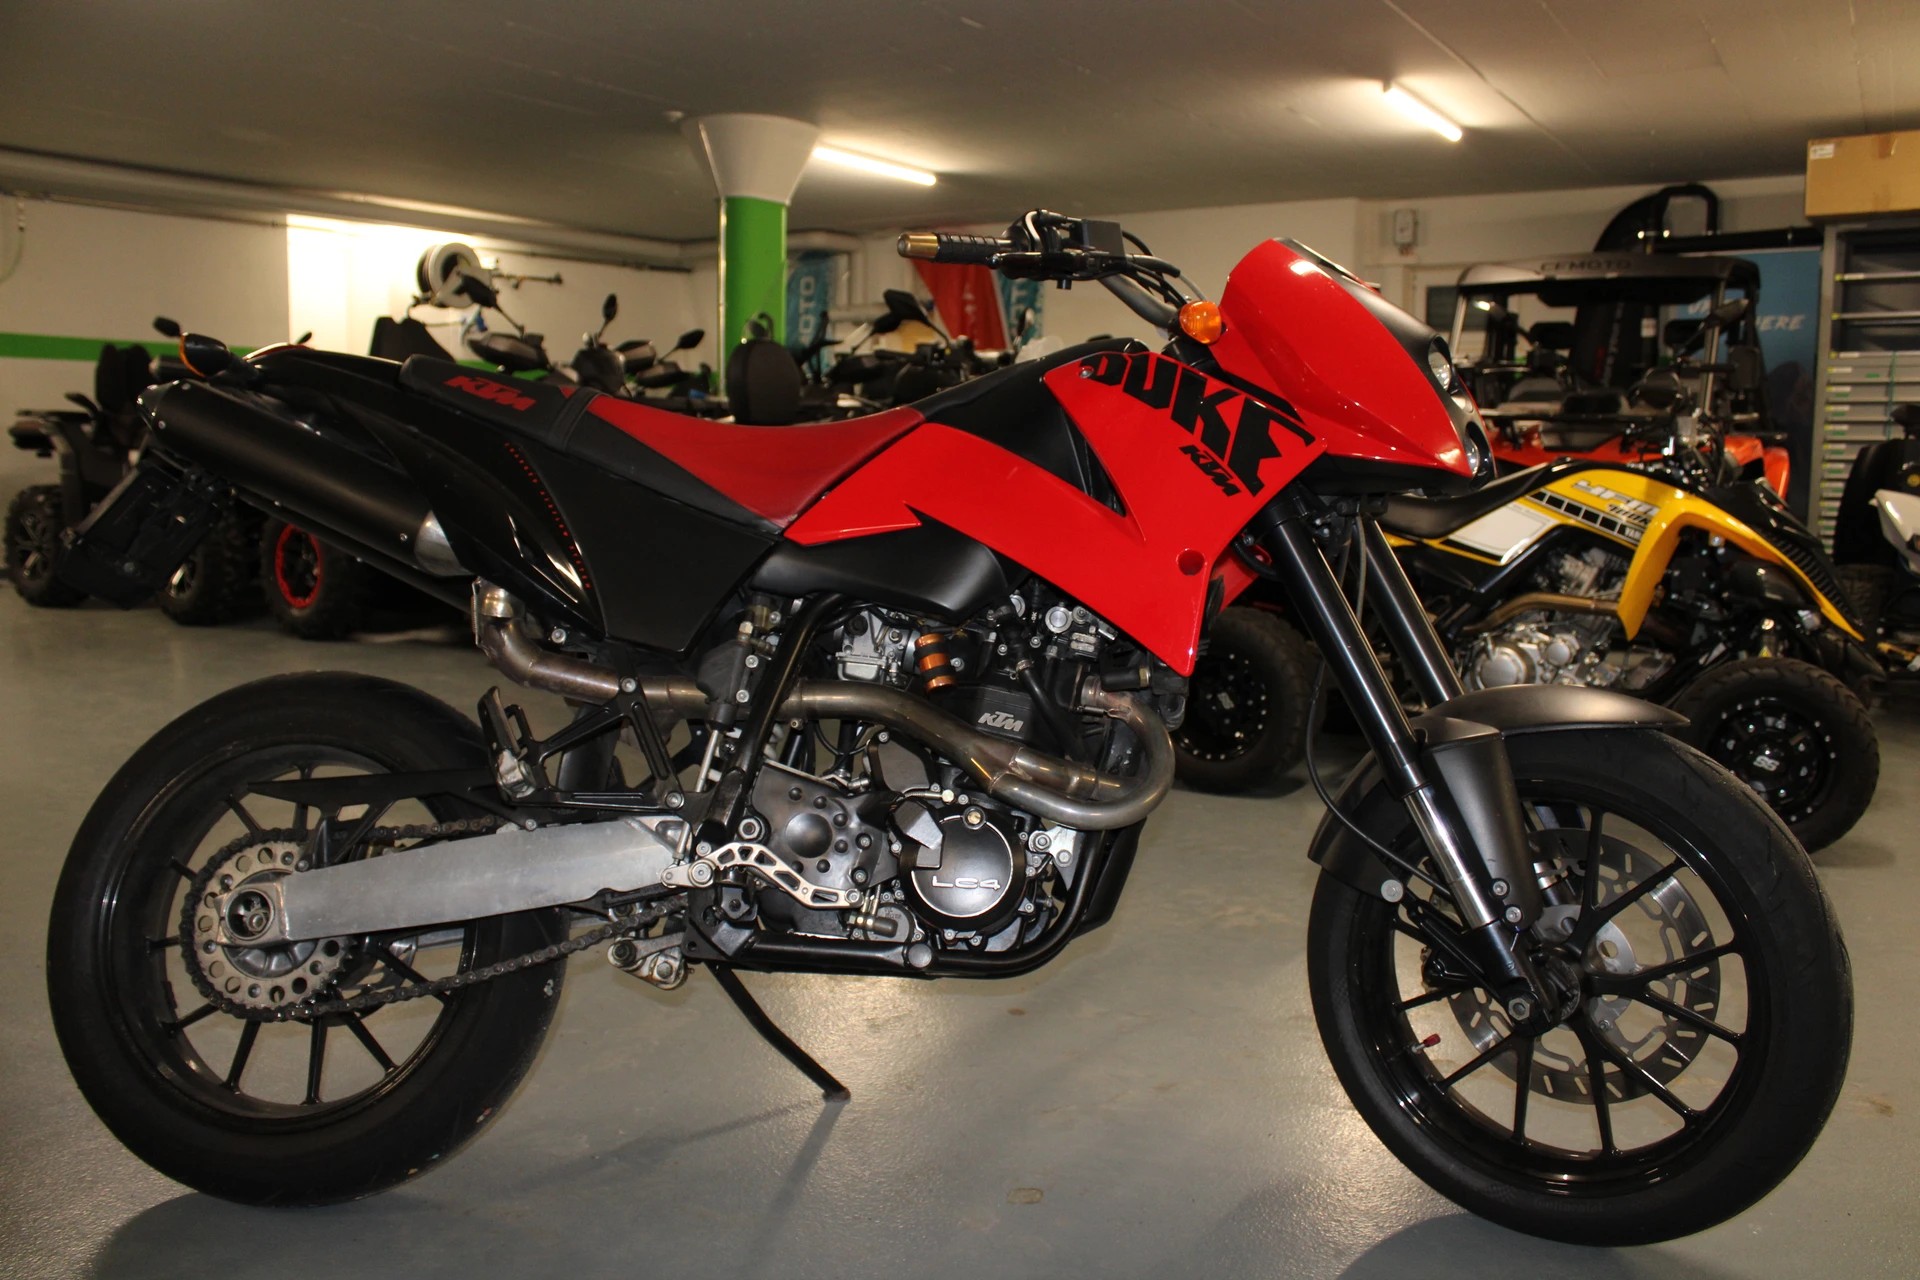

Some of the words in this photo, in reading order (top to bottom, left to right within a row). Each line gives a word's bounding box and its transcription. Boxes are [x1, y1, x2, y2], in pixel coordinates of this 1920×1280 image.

[444, 376, 536, 411] KTM
[1079, 354, 1316, 497] DUKE
[1178, 444, 1241, 497] KTM
[978, 711, 1024, 732] KTM
[932, 875, 1001, 890] LC4
